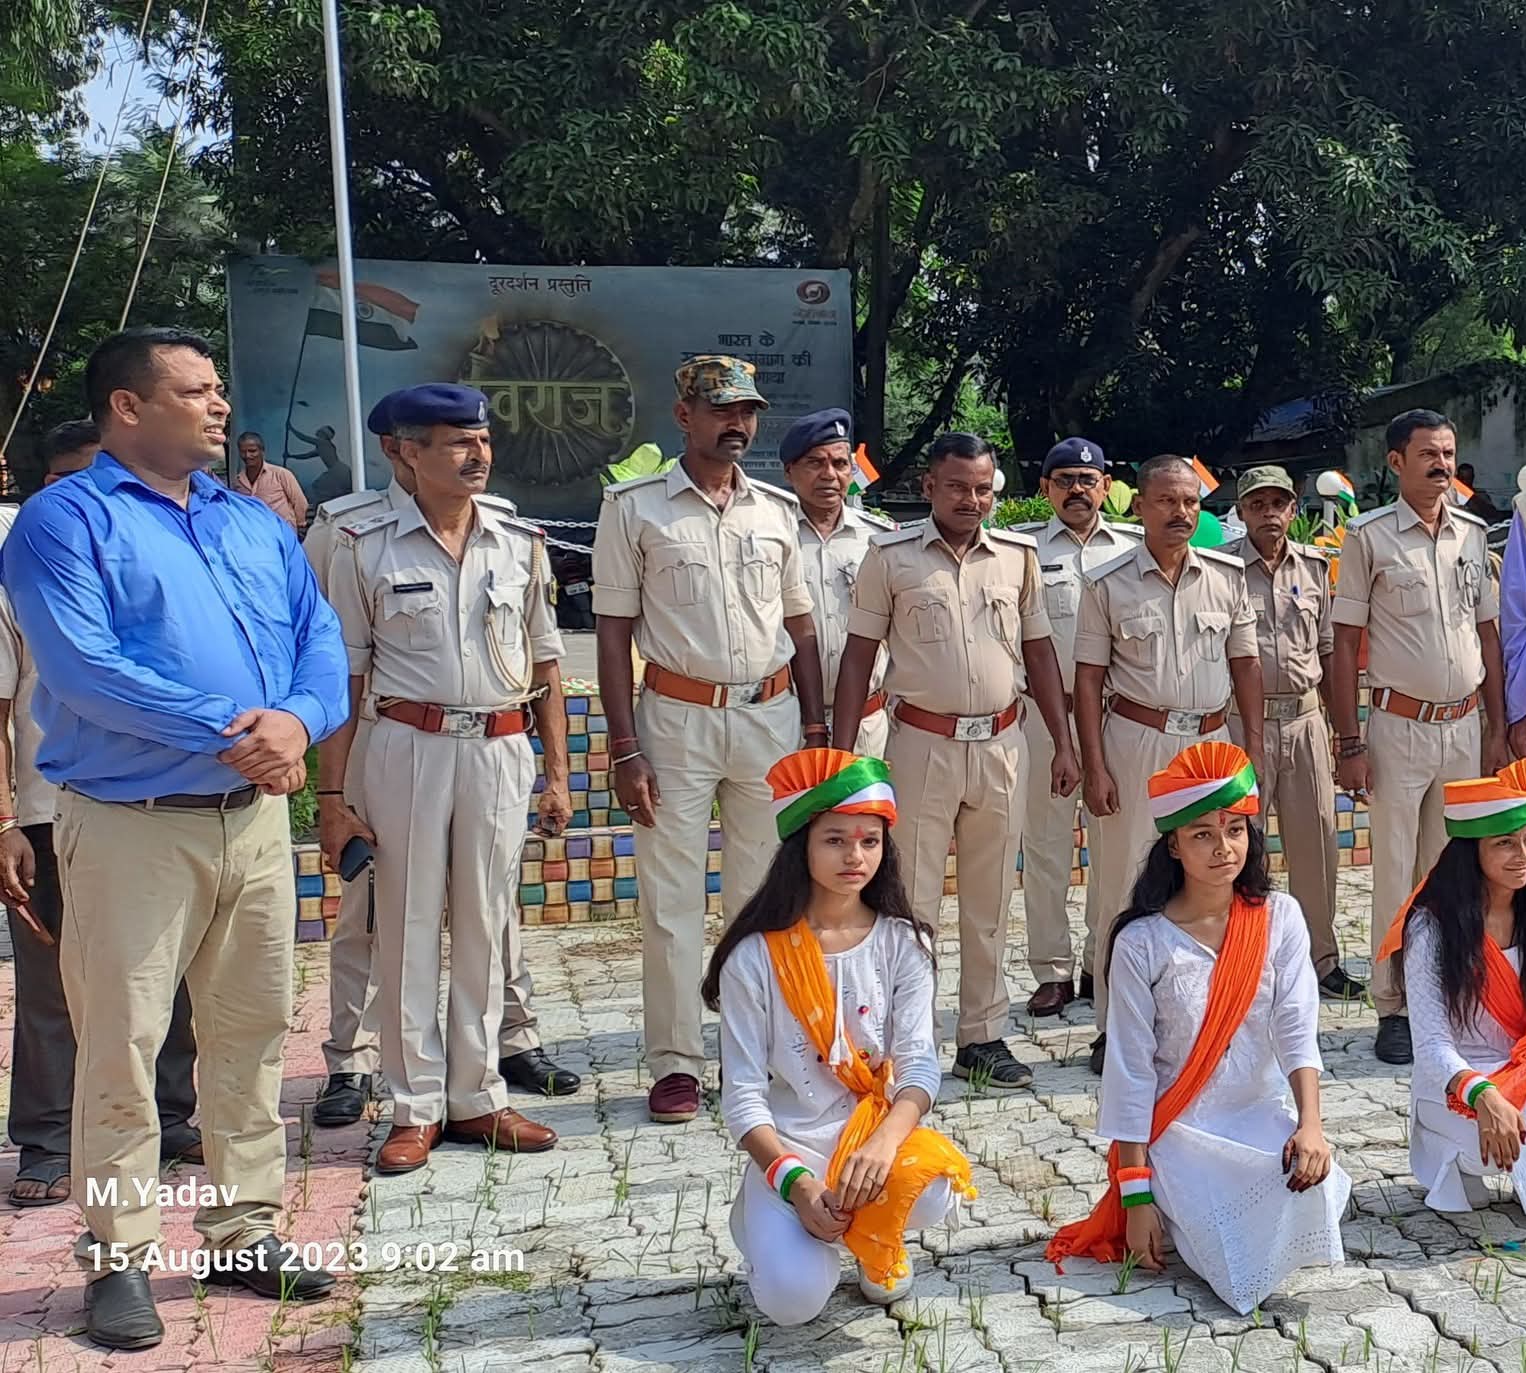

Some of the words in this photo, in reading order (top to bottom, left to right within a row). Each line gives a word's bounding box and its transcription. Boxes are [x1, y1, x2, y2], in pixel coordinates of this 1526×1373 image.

[488, 272, 539, 296] दूरदर्शन
[547, 274, 592, 298] प्रस्तुति
[718, 334, 751, 347] भारत
[760, 330, 776, 347] के
[792, 350, 811, 367] की
[459, 380, 630, 439] वराज
